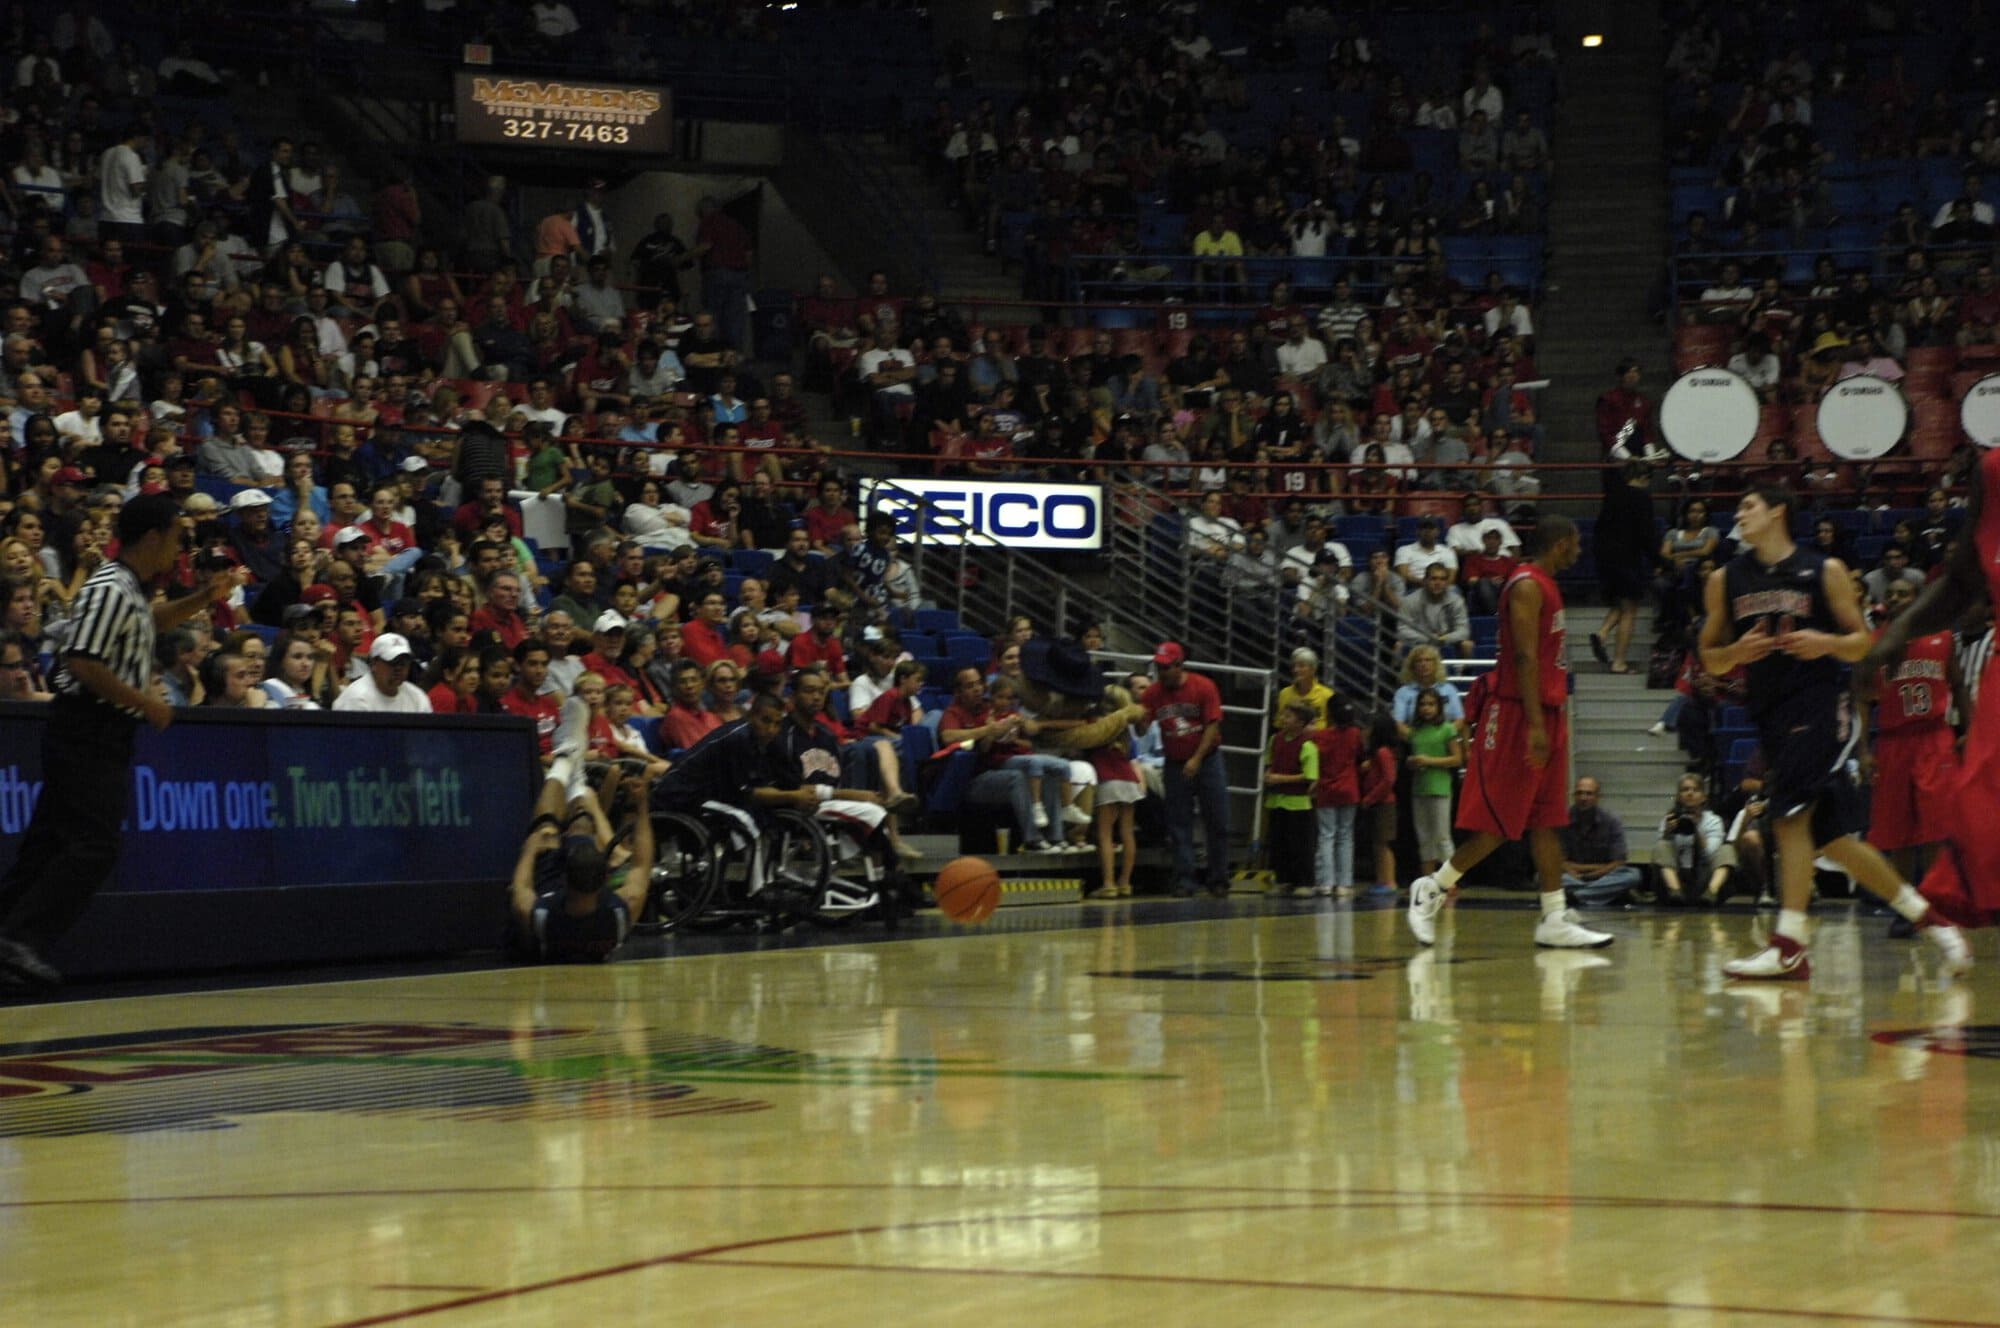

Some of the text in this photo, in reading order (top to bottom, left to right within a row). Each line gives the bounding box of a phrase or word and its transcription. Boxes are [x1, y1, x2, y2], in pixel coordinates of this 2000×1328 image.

[503, 119, 630, 144] 327-7463
[1168, 312, 1187, 329] 19
[1284, 471, 1306, 492] 19
[868, 487, 1096, 540] GEICO
[1898, 682, 1933, 717] 13
[134, 764, 220, 832] Down
[224, 780, 287, 830] one.
[287, 765, 342, 828] Two
[347, 767, 412, 828] ticks
[415, 767, 472, 828] left.
